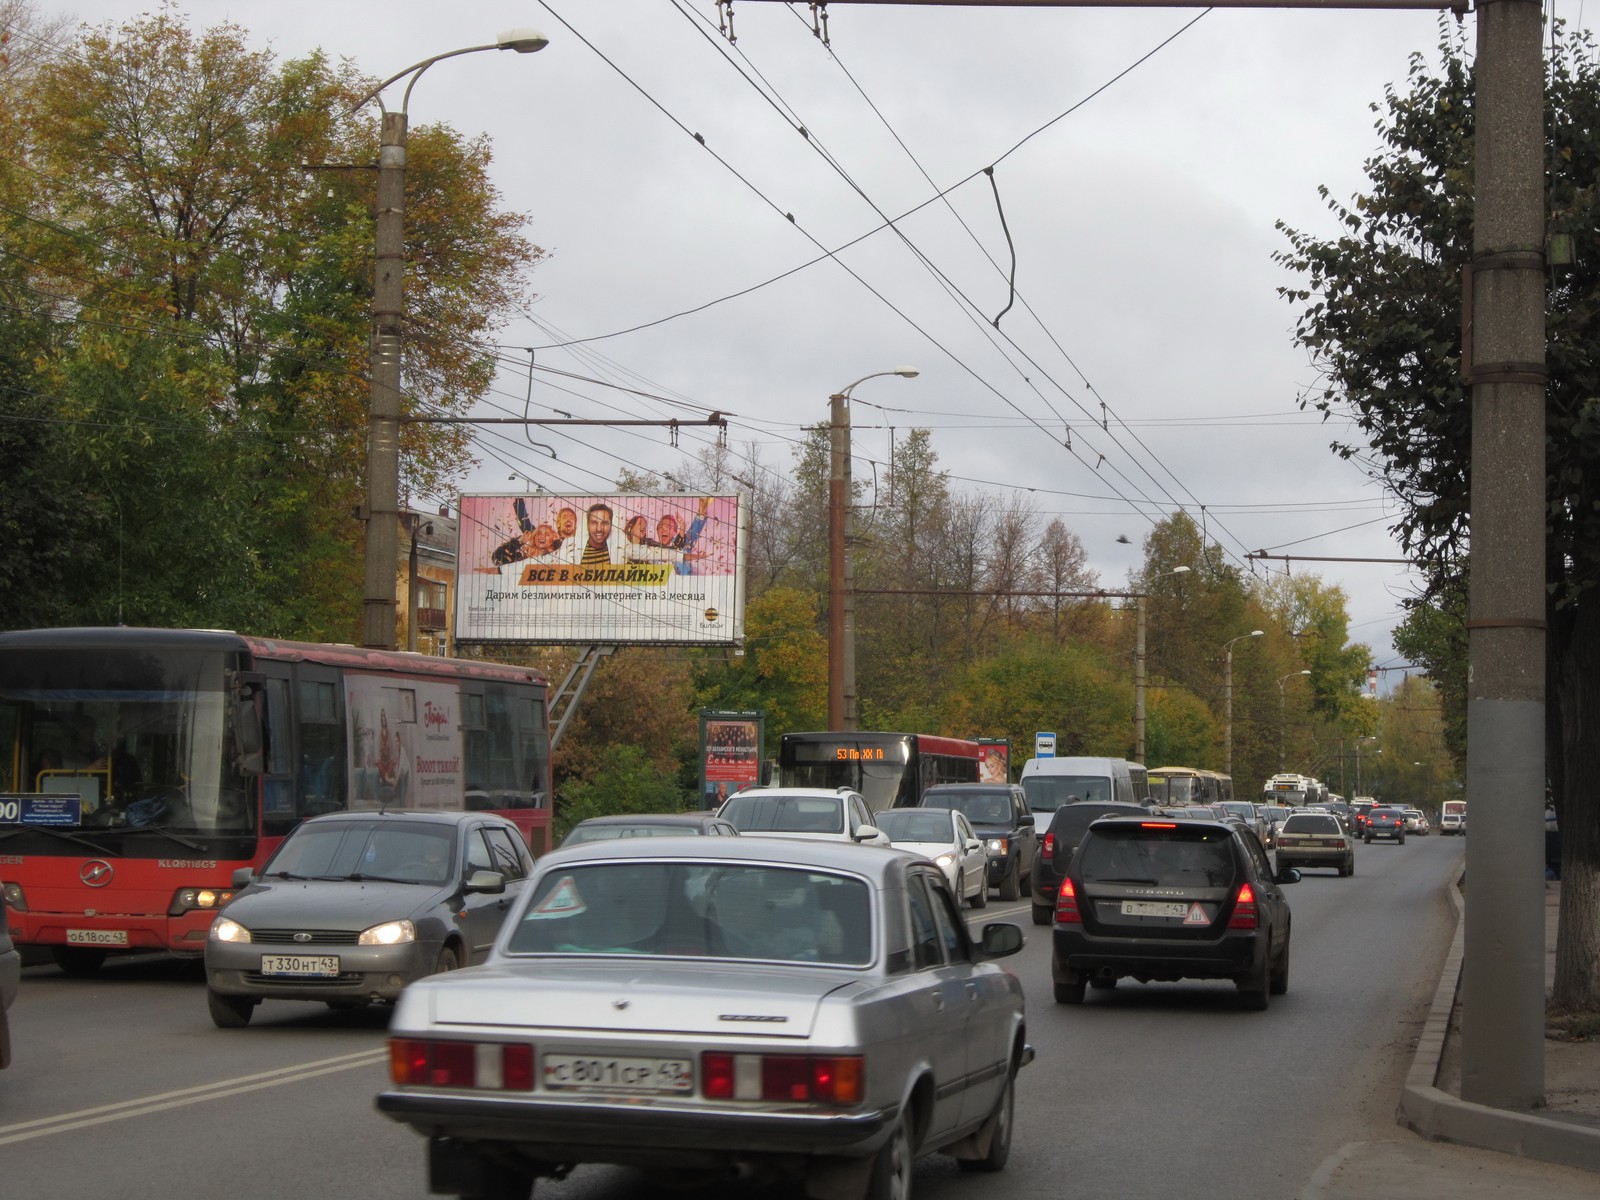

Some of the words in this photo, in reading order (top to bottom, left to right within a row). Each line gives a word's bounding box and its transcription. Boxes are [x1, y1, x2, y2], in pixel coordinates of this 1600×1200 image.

[527, 569, 555, 581] ВСЕ
[559, 569, 569, 581] В
[573, 566, 665, 582] «БИЛАЙН»!
[486, 589, 519, 601] Дарим
[521, 589, 592, 600] безлимитный
[594, 592, 642, 602] интернет
[645, 592, 657, 600] на
[660, 591, 665, 600] 3
[669, 592, 706, 602] месяца
[837, 748, 847, 759] 53
[436, 755, 459, 773] такой!
[158, 859, 216, 869] KLQ6118GS
[1172, 904, 1184, 913] 43
[113, 931, 124, 941] 43
[267, 957, 317, 971] Т330НТ
[321, 958, 334, 968] 43
[555, 1060, 651, 1084] С801СР
